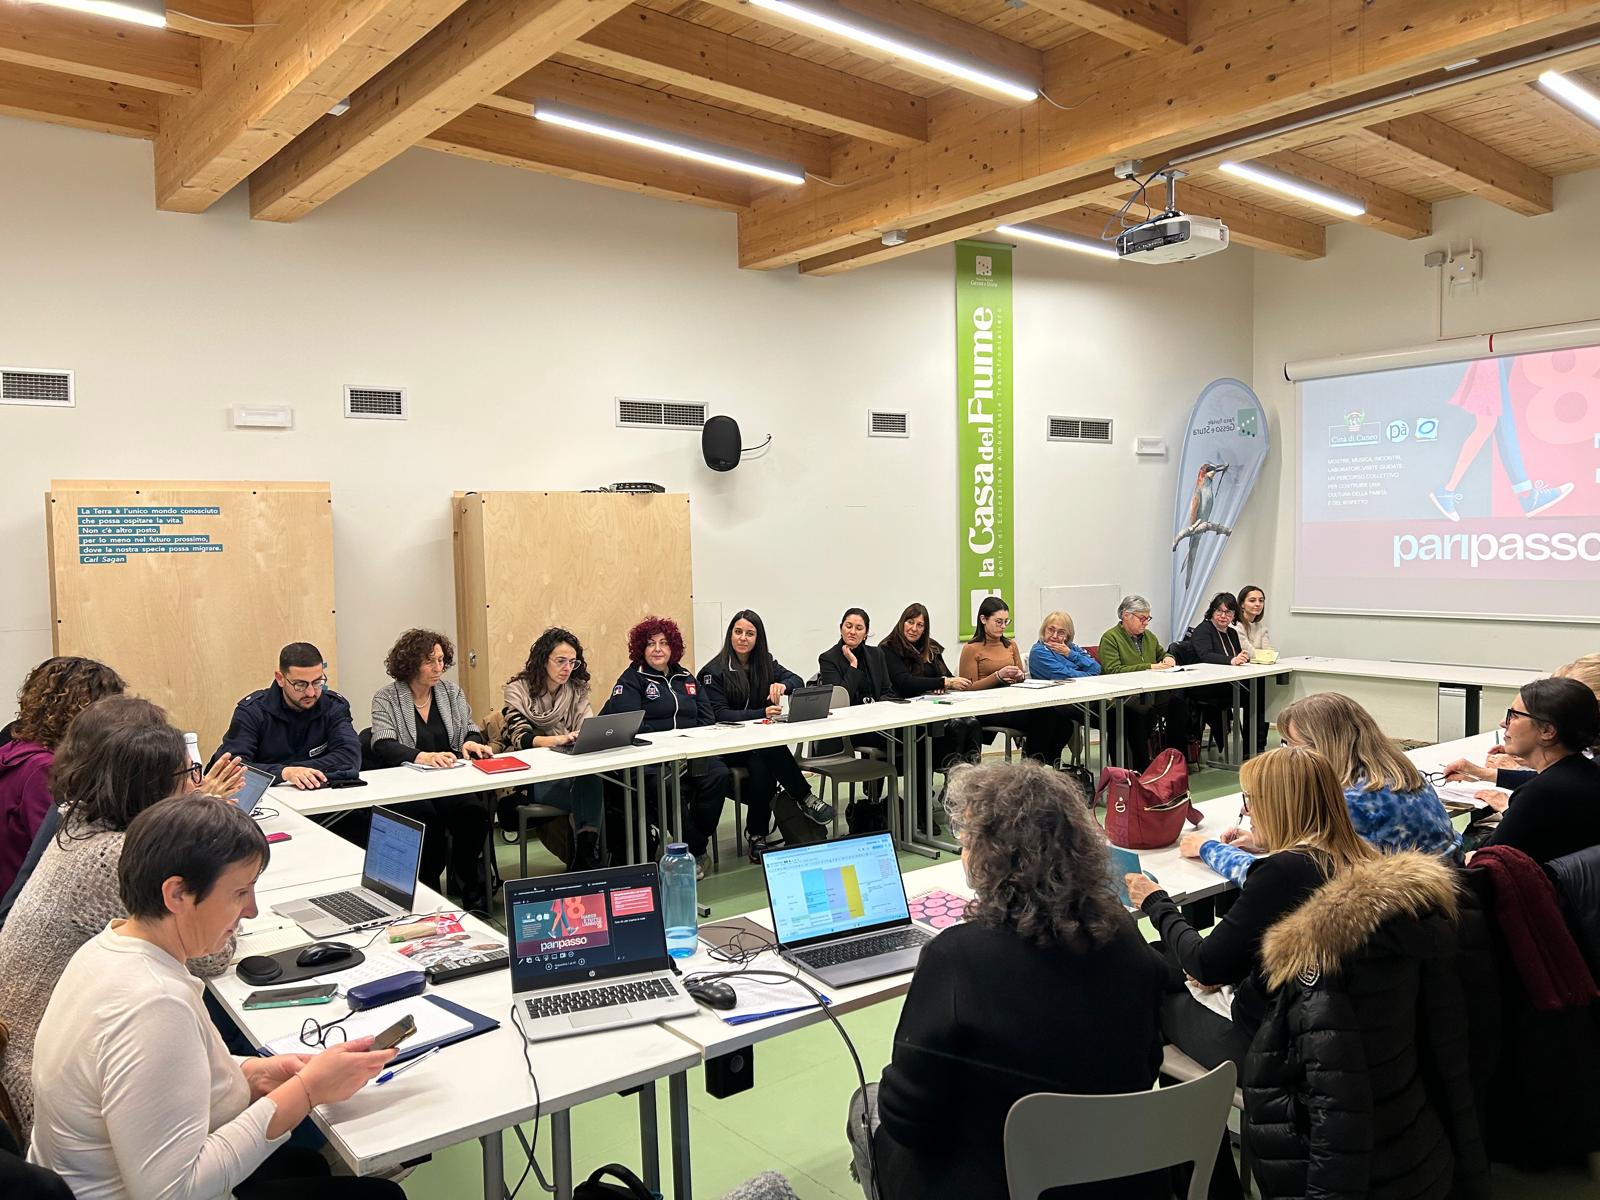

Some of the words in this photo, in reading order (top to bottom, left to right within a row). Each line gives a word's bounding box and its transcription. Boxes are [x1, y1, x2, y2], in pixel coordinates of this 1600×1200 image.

[967, 306, 994, 424] Fiume
[977, 427, 994, 461] del
[93, 507, 112, 515] Terra
[968, 463, 995, 554] Casa
[123, 517, 154, 525] ospitare
[174, 536, 209, 544] prossimo,
[142, 545, 166, 553] specie
[192, 545, 222, 553] migrare.
[101, 556, 125, 564] Sagan
[978, 558, 995, 578] la
